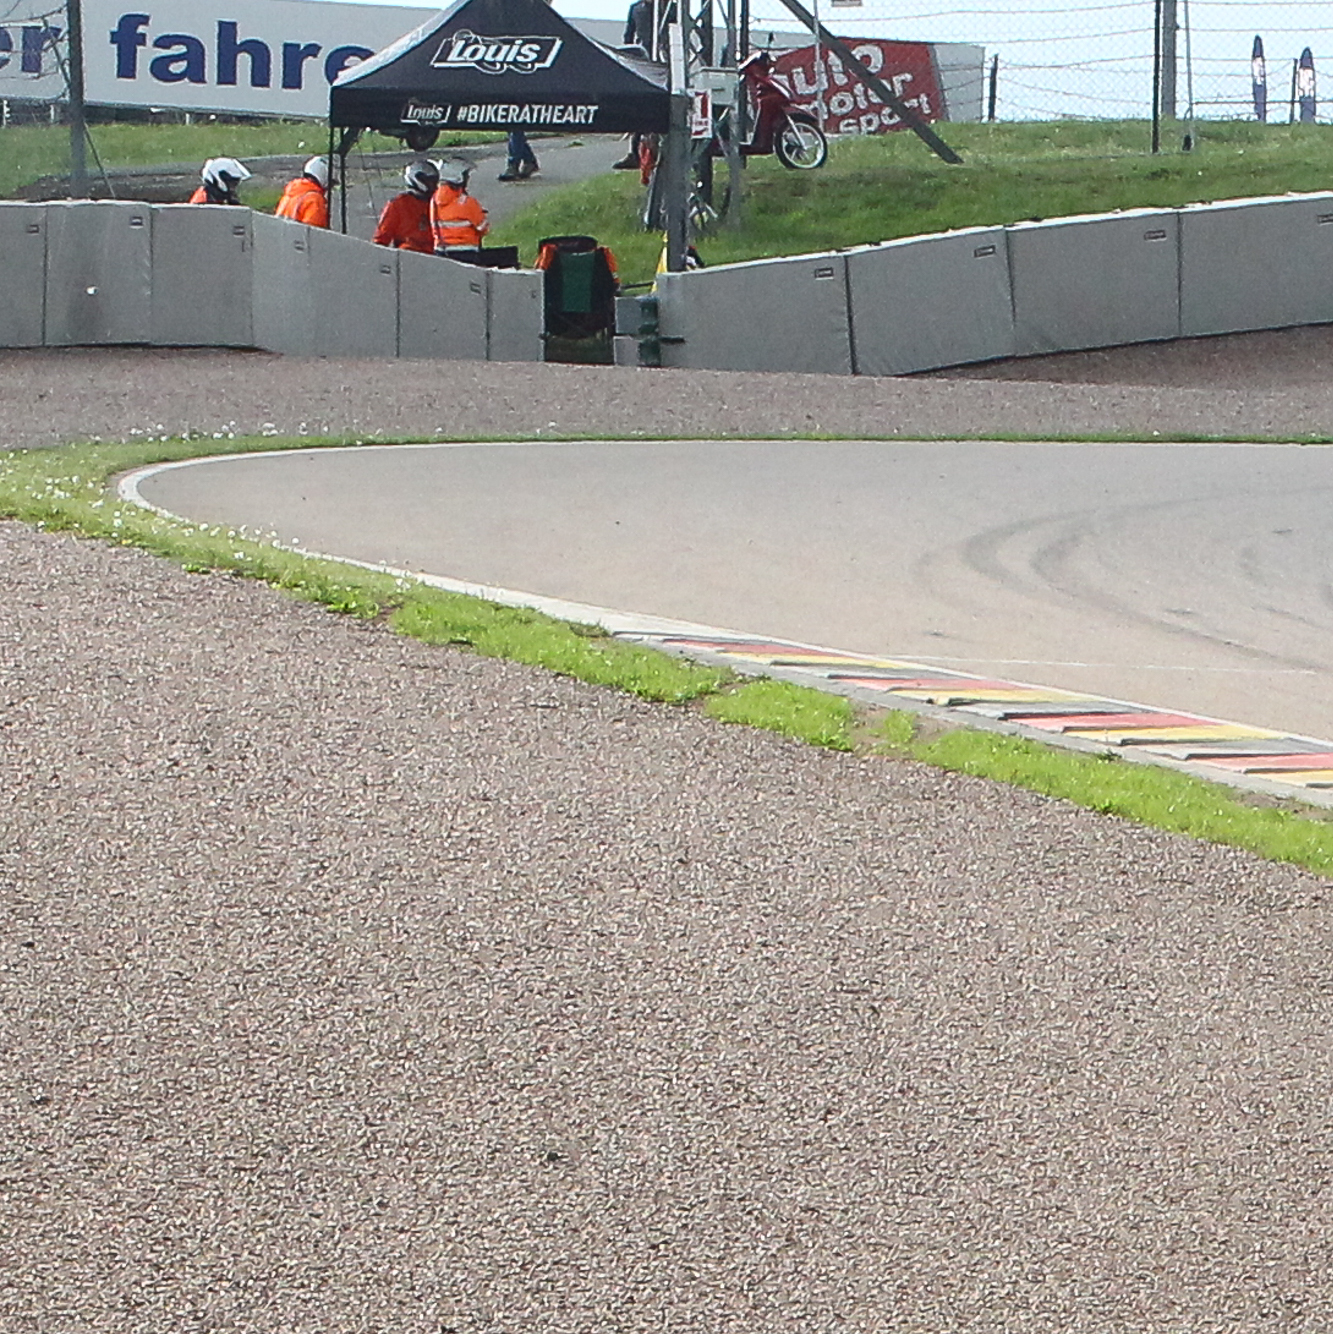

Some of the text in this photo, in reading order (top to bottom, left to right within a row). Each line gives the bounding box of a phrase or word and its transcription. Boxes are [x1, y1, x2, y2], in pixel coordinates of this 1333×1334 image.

[0, 27, 61, 73] r
[447, 39, 540, 62] Louis
[407, 104, 599, 124] Louis #BIKERATHEART
